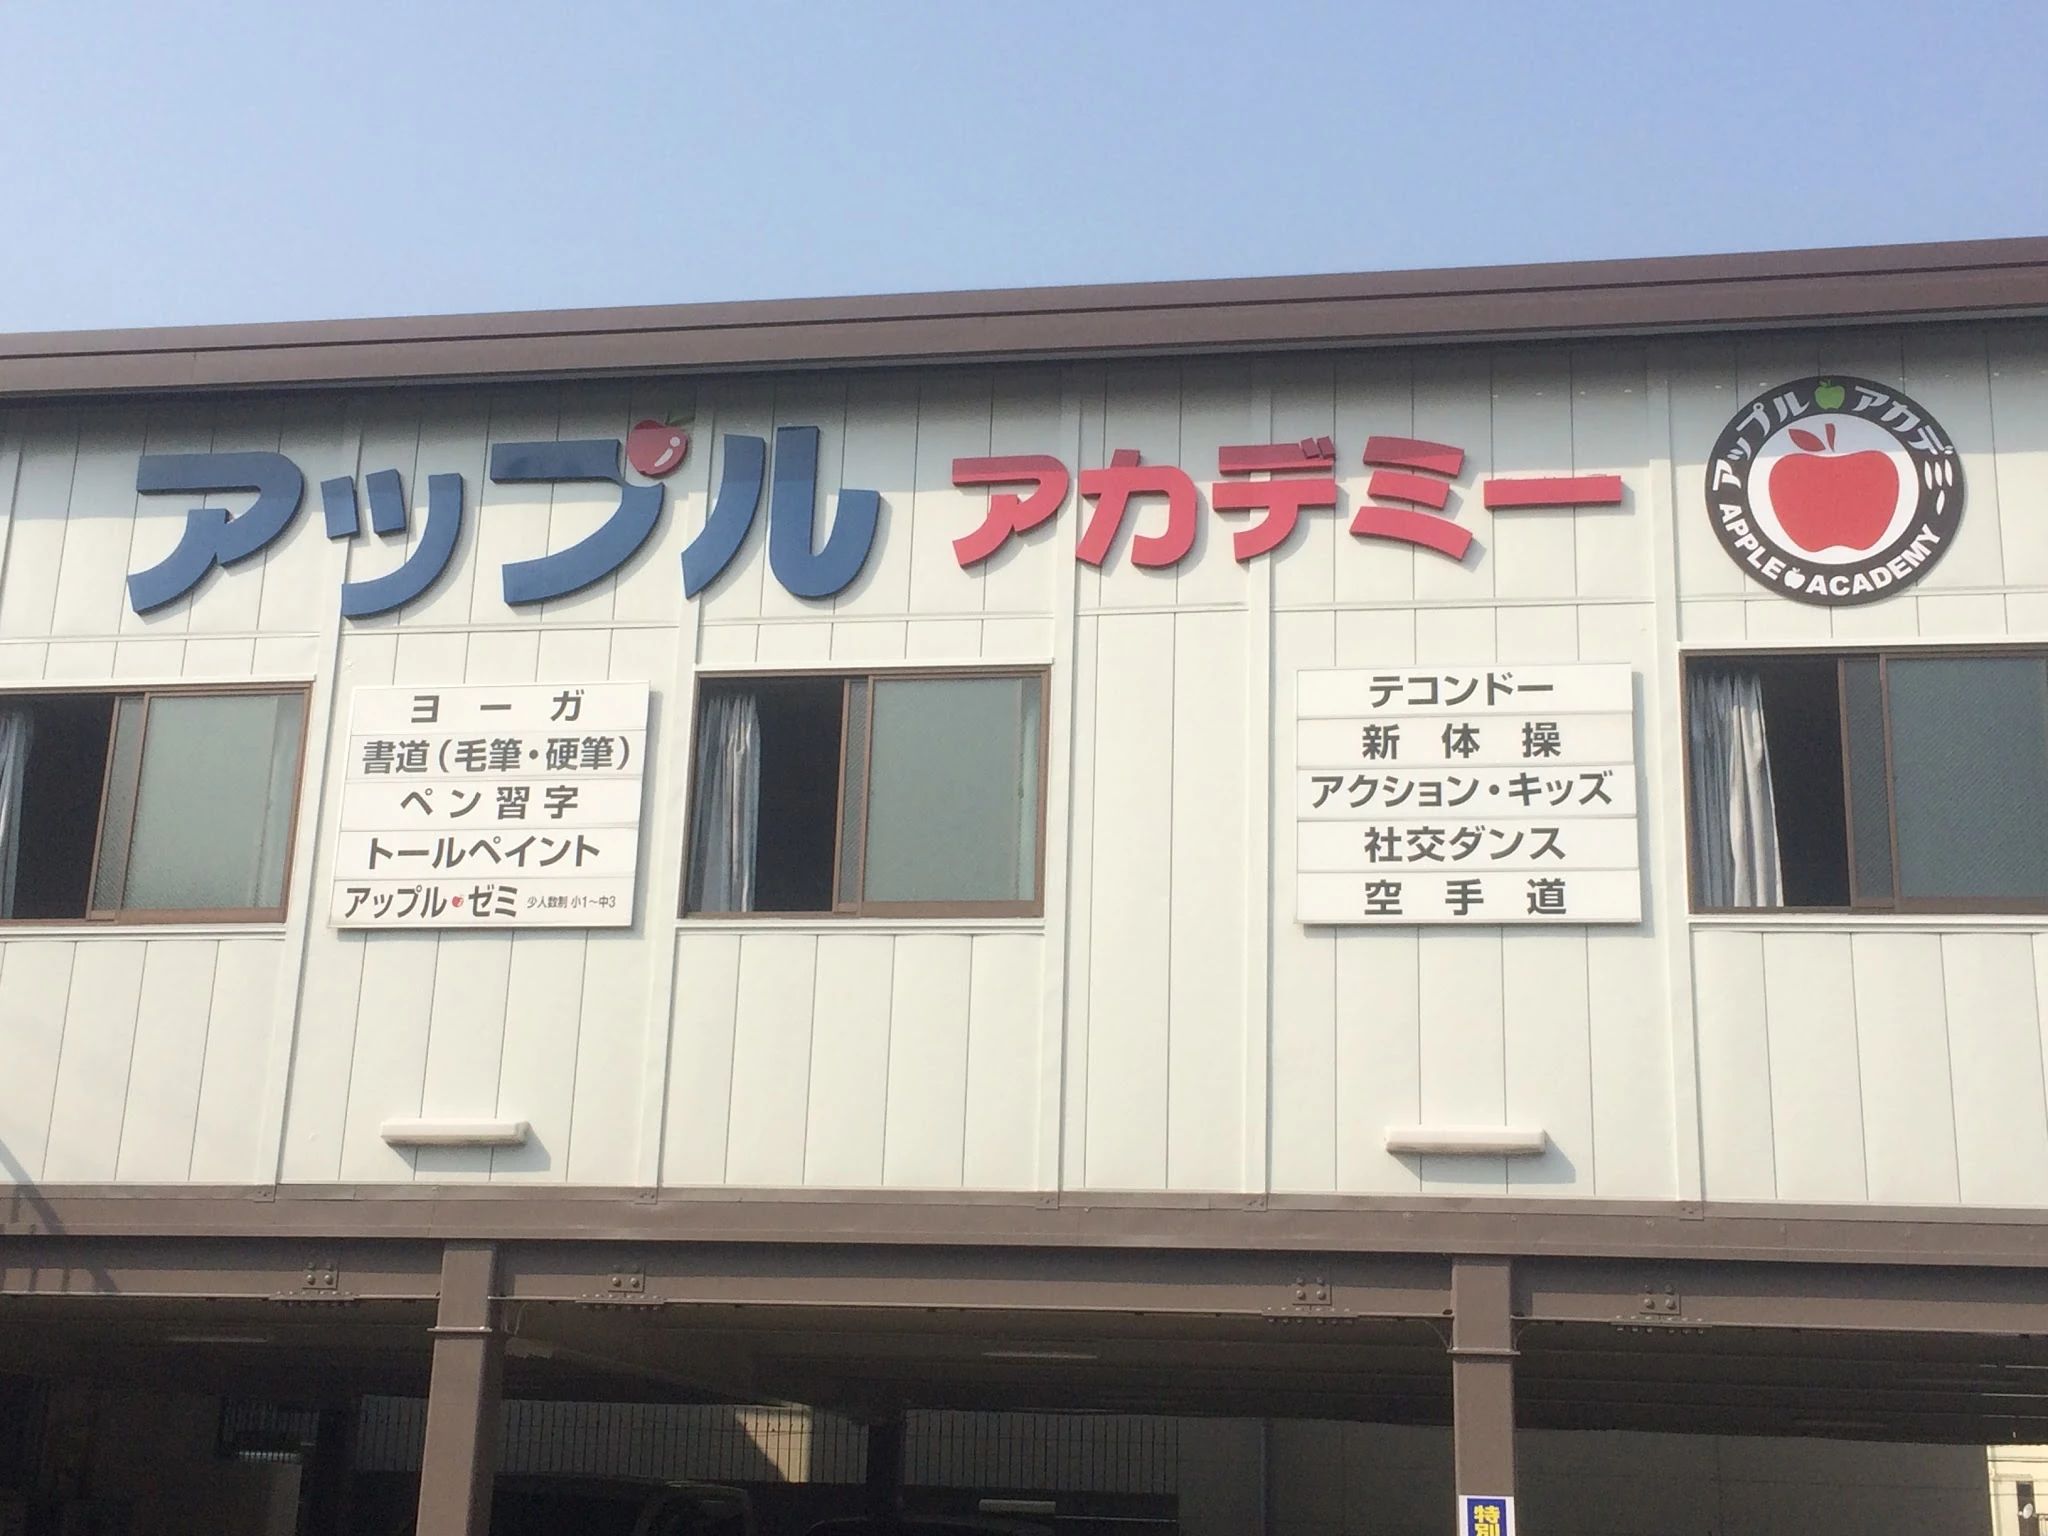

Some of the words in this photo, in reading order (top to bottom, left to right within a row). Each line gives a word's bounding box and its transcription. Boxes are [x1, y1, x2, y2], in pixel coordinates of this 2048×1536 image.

[1712, 391, 1810, 491] アップル
[1852, 385, 1955, 516] アカデミー
[127, 417, 880, 620] アップル
[952, 436, 1623, 569] アカデミー
[1719, 503, 1787, 581] APPLE
[1805, 523, 1941, 597] ACADEMY
[411, 689, 585, 723] ヨーガ
[1369, 672, 1554, 708] テコンドー
[1362, 721, 1562, 760] 新体操
[400, 785, 579, 820] ペン習字
[1311, 769, 1614, 808] アクション・キッズ
[368, 835, 600, 870] トールペイント
[1364, 825, 1566, 863] 社交ダンス
[1364, 878, 1567, 916] 空手道
